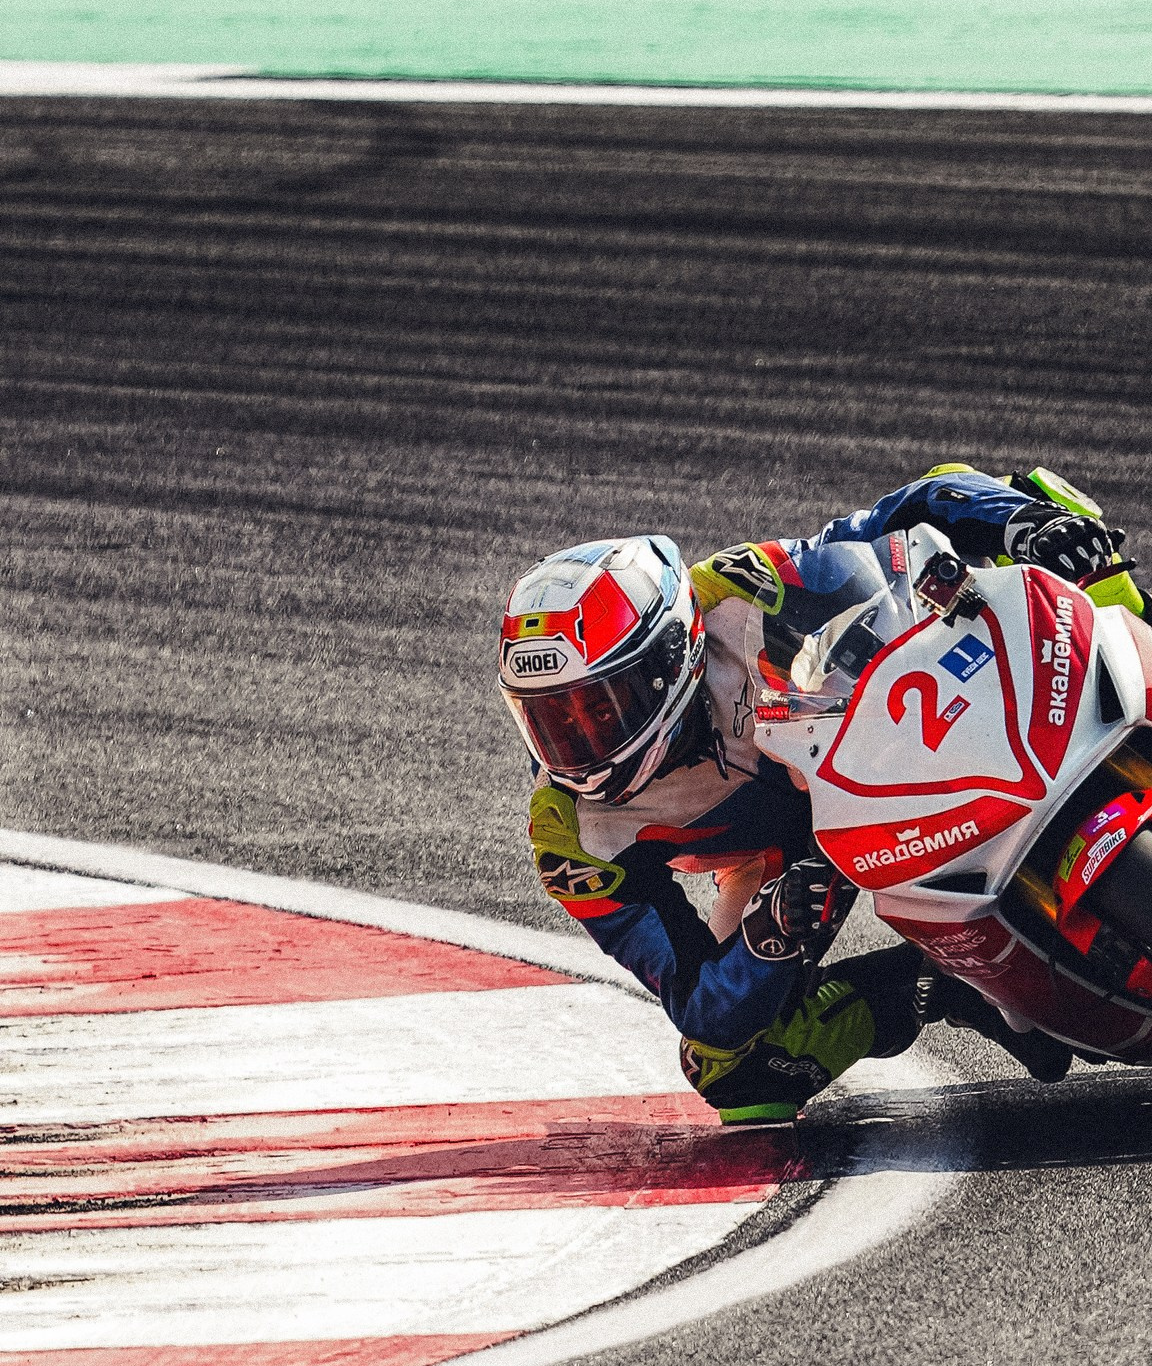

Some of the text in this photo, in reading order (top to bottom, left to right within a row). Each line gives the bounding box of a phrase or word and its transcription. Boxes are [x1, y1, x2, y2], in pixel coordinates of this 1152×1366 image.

[515, 653, 560, 674] SHOEI
[1048, 595, 1074, 726] академия
[886, 670, 971, 752] 2
[852, 820, 980, 873] академия
[1083, 831, 1124, 882] SUPERBIKE
